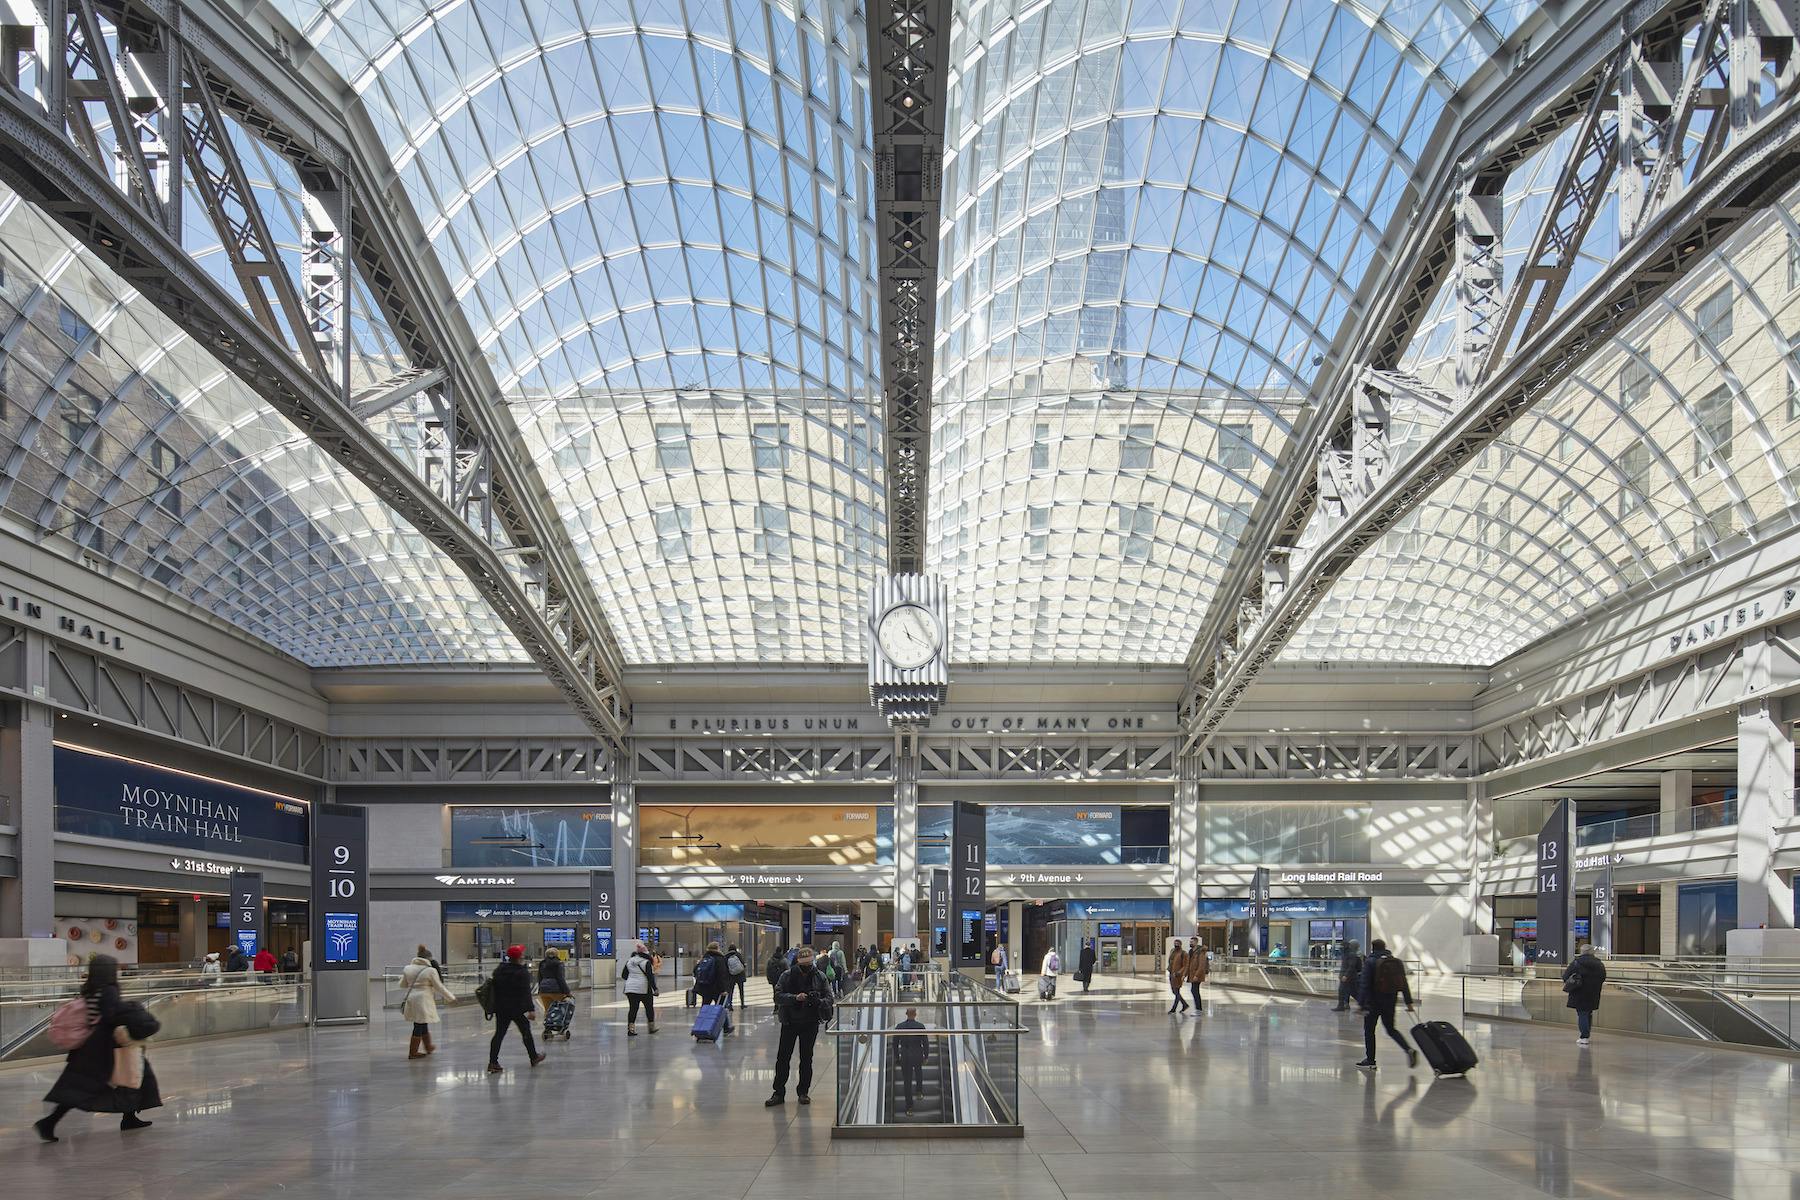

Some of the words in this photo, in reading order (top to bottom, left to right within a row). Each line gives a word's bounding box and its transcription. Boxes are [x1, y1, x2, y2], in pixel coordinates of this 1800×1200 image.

[58, 616, 124, 650] HALL
[1670, 602, 1764, 653] DANIEL
[670, 719, 676, 730] E
[691, 719, 789, 730] PLURIBUS
[805, 719, 858, 730] UNUM
[952, 718, 989, 729] OUT
[1002, 718, 1024, 729] OF
[1037, 718, 1090, 729] MANY
[1108, 718, 1144, 729] ONE
[122, 784, 240, 823] MOYNIHAN
[119, 806, 188, 834] TRAIN
[195, 819, 242, 843] HALL
[333, 845, 350, 865] 9
[966, 844, 979, 864] 11
[1541, 841, 1557, 861] 13
[1590, 855, 1610, 866] Hall
[184, 860, 205, 873] 31st
[206, 862, 234, 875] Street
[457, 877, 516, 885] AMTRAK
[740, 875, 755, 884] 9th
[758, 875, 792, 884] Avenue
[1020, 873, 1035, 883] 9th
[1038, 873, 1072, 883] Avenue
[1282, 872, 1306, 884] Long
[1307, 872, 1336, 881] Island
[1338, 872, 1356, 881] Rail
[1358, 872, 1383, 881] Road
[1540, 873, 1558, 893] 14
[328, 878, 356, 899] 10
[966, 876, 981, 896] 12
[243, 893, 253, 905] 7
[600, 892, 608, 904] 9
[937, 890, 945, 902] 11
[1595, 887, 1605, 899] 15
[512, 909, 533, 917] Ticketing
[544, 909, 564, 917] Baggage
[598, 909, 611, 921] 10
[936, 908, 946, 919] 12
[1595, 904, 1606, 916] 16
[242, 911, 252, 923] 8
